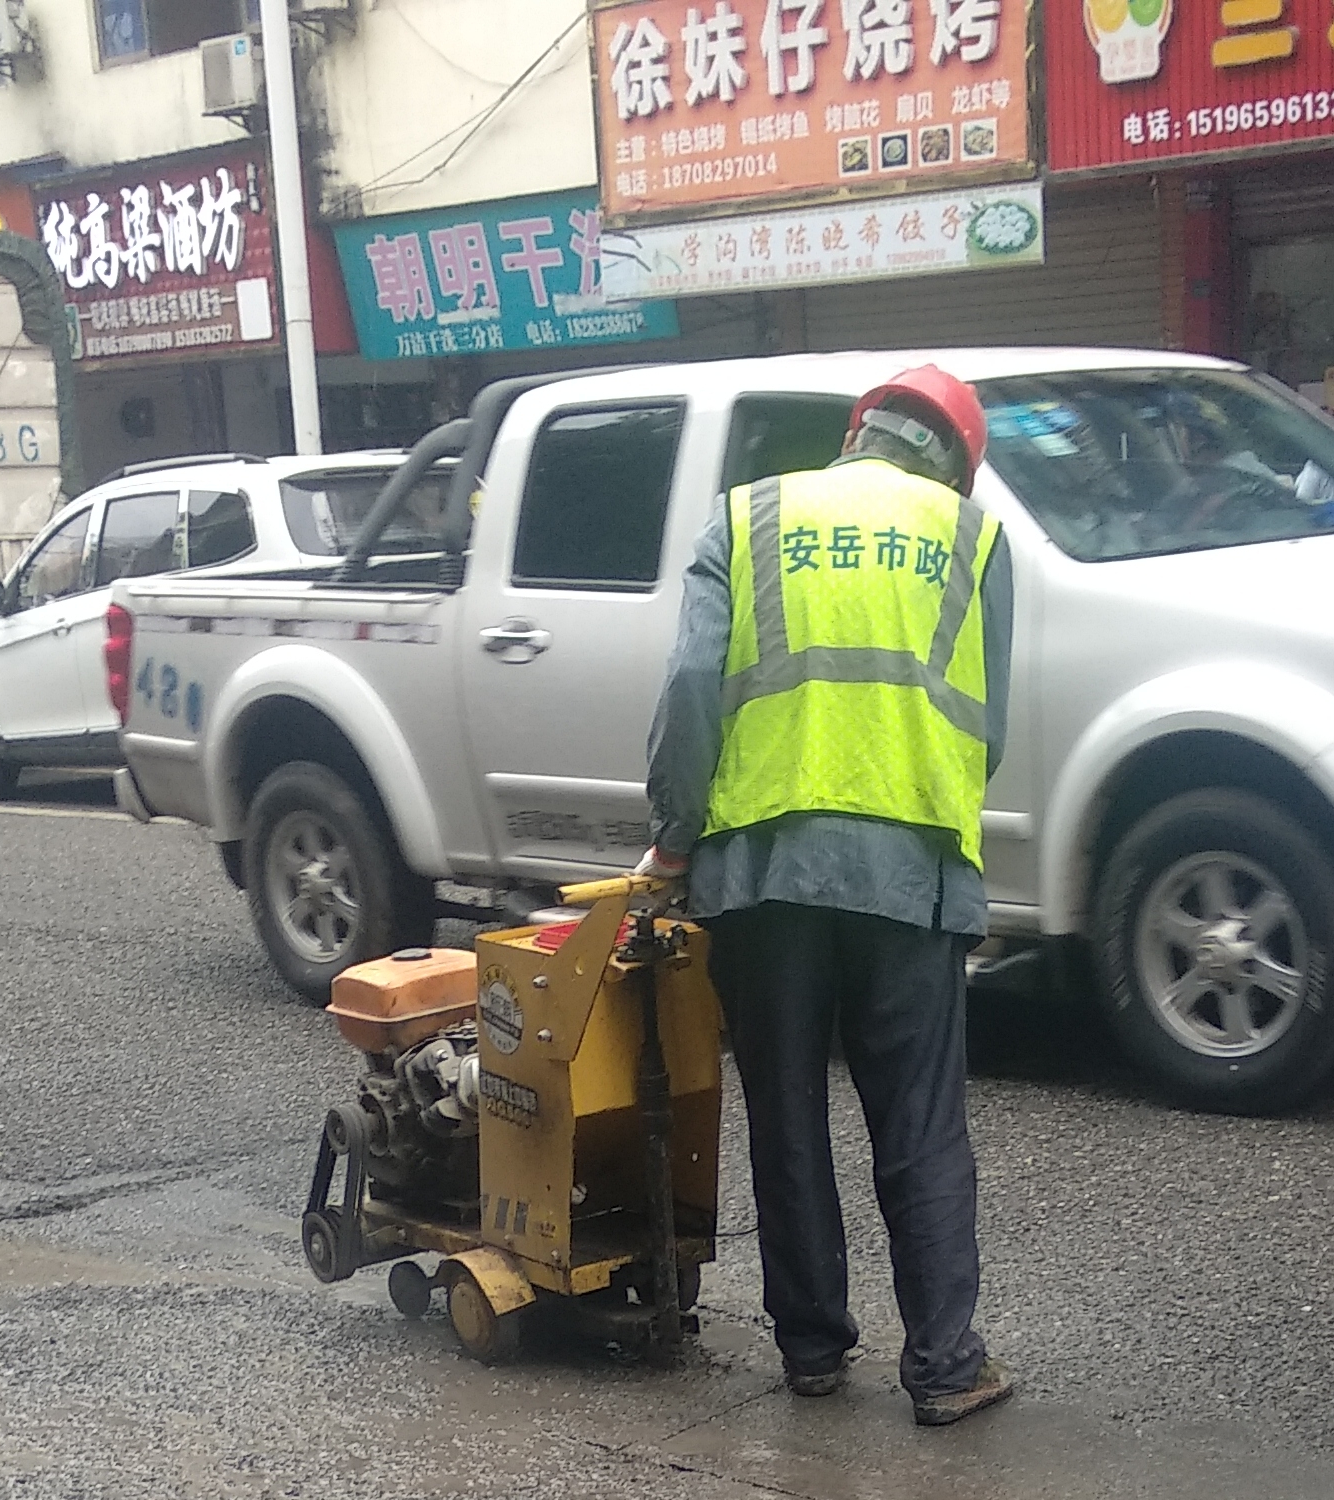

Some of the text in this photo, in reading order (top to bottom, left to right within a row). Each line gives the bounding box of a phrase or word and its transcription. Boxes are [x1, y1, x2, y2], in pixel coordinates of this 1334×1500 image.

[608, 0, 1001, 120] 徐妹仔烧烤
[952, 77, 1011, 115] 龙虾等
[782, 525, 951, 589] 安岳市政
